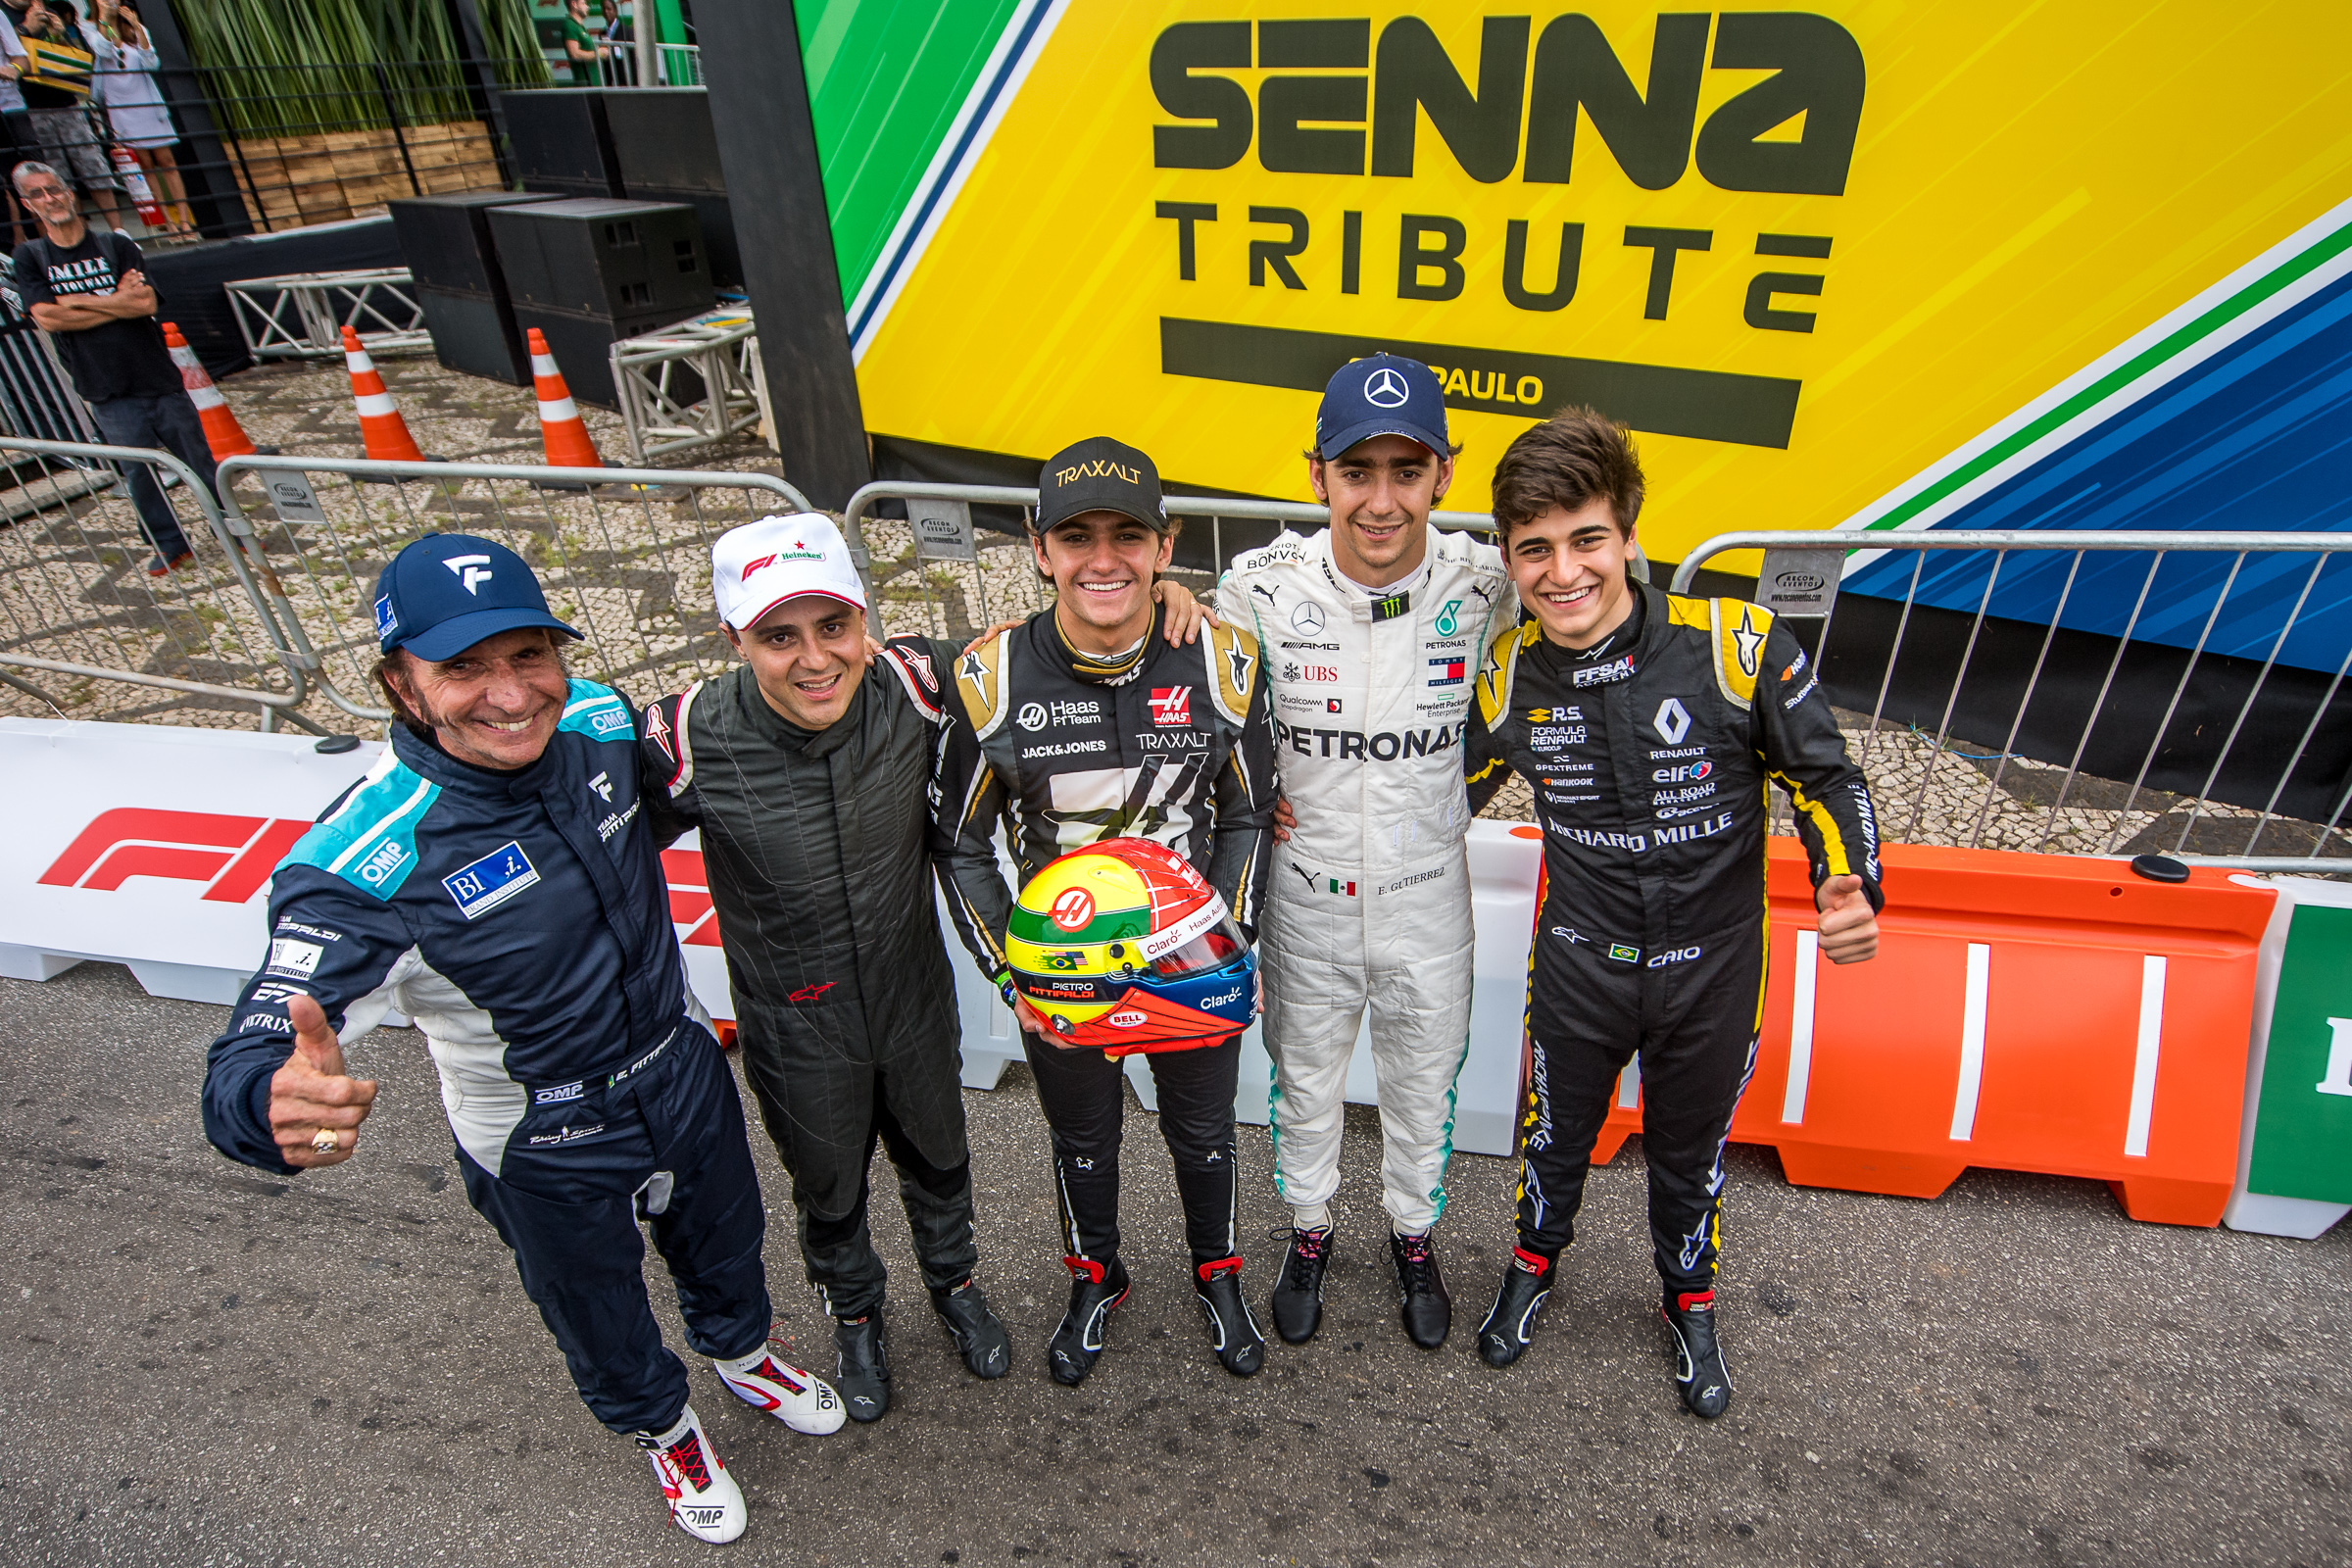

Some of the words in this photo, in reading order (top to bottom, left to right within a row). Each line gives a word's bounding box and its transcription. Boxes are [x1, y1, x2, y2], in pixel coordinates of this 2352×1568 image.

[1150, 12, 1866, 196] SENNA
[1155, 200, 1833, 333] TRIBUTE
[62, 279, 85, 293] YOU
[84, 273, 117, 289] WANT
[1428, 366, 1544, 405] PAULO
[1055, 460, 1141, 487] TRAXALT
[1426, 640, 1466, 649] PETRONAS
[1303, 665, 1338, 682] UBS
[1573, 659, 1628, 685] FFSA
[1050, 700, 1100, 716] Haas
[1280, 694, 1323, 706] Qualcomm
[1417, 700, 1446, 710] Hewlett
[592, 712, 627, 731] OMP
[1068, 714, 1102, 725] Team
[1154, 711, 1190, 723] HAAS
[1428, 707, 1460, 717] Enterprise
[1530, 734, 1588, 746] RENAULT
[1532, 725, 1586, 736] FORMULA
[1021, 740, 1107, 759] JACK&JONES
[1136, 732, 1211, 750] TRAXALT
[1650, 747, 1706, 760] RENAULT
[1654, 790, 1677, 802] ALL
[1680, 782, 1716, 799] ROAD
[597, 812, 617, 833] TEAM
[1549, 815, 1646, 853] RICHARD
[1654, 811, 1733, 846] MILLE
[362, 842, 402, 882] OMP
[451, 871, 486, 901] BI
[1378, 886, 1387, 896] E.
[1391, 867, 1445, 892] GUTIERREZ
[466, 896, 494, 914] BRAND
[495, 871, 535, 898] INSTITUTE
[1148, 932, 1180, 955] Claro
[1189, 915, 1211, 931] Haas
[1647, 946, 1701, 968] CAIO
[1029, 986, 1095, 998] FITTIPALDI
[1053, 982, 1094, 991] PIETRO
[1200, 989, 1239, 1009] Claro
[1113, 1014, 1142, 1023] BELL
[536, 1083, 583, 1102] OMP
